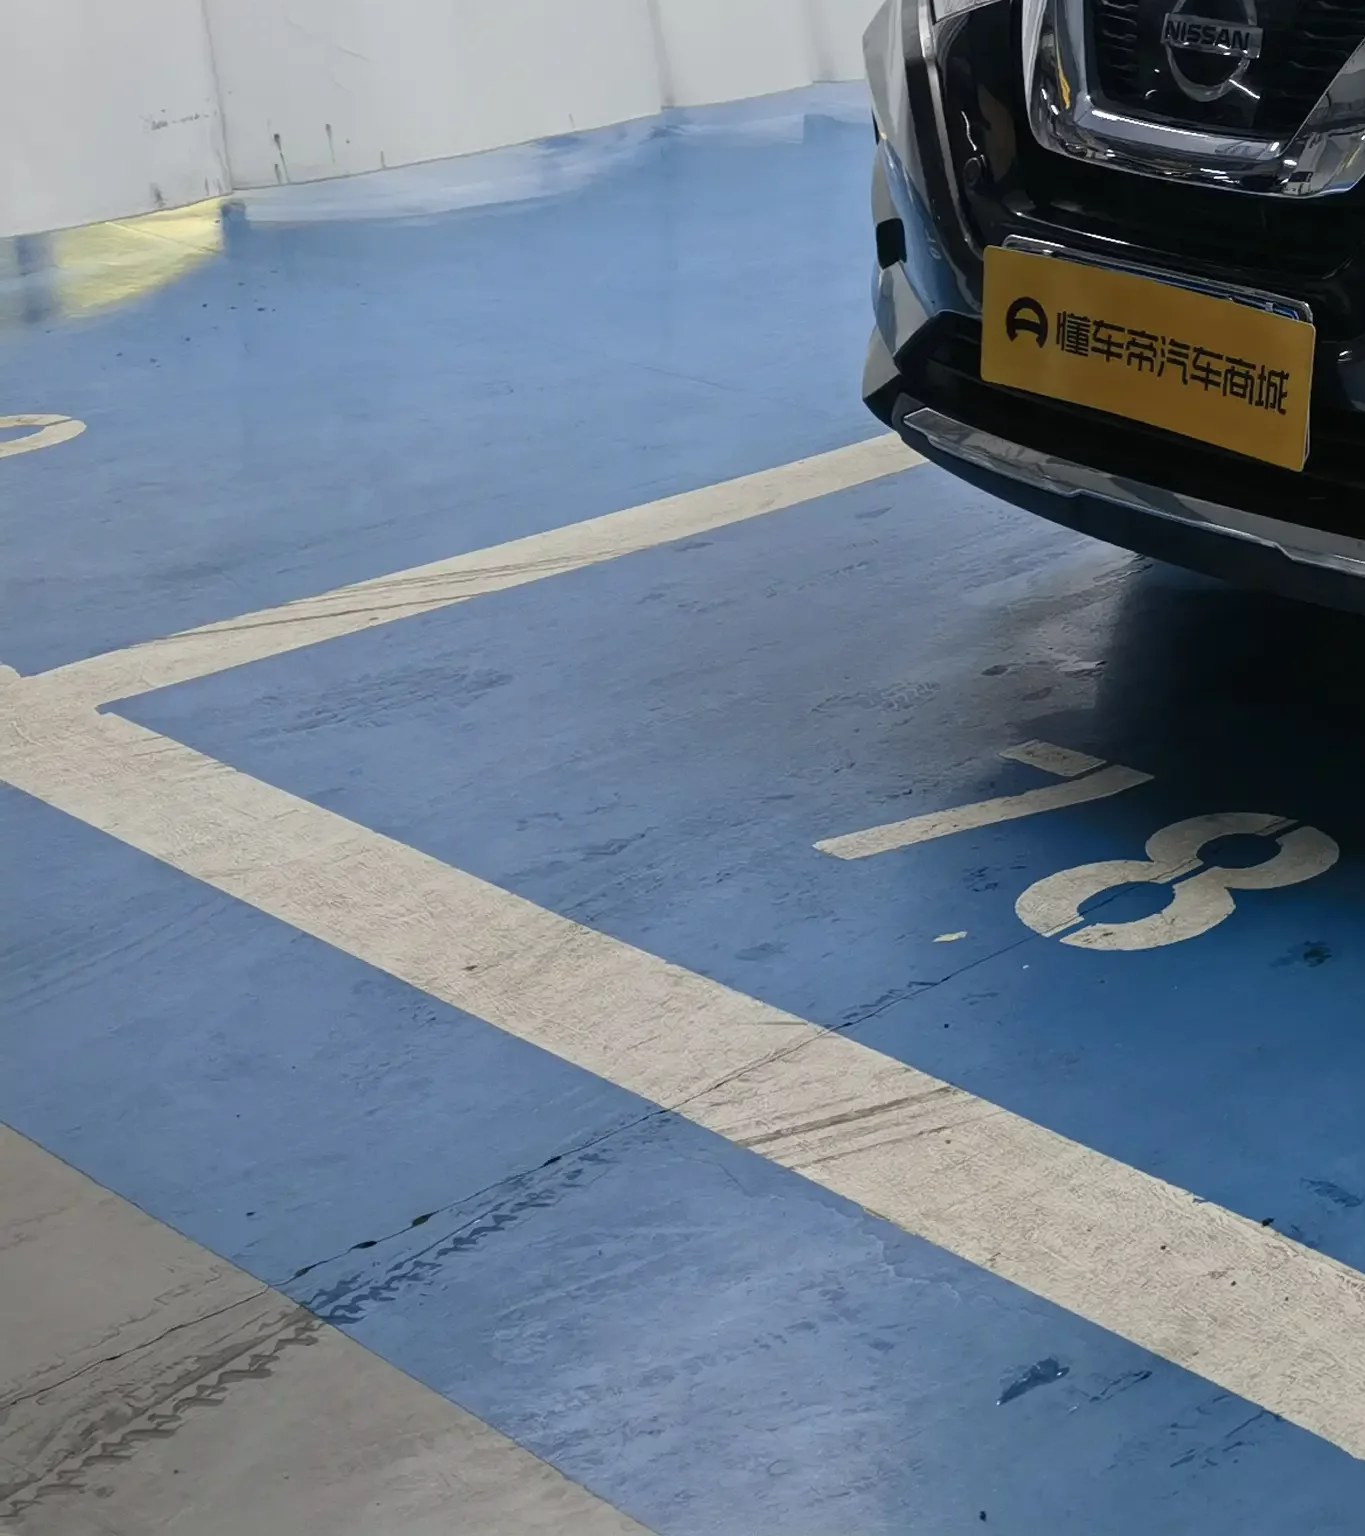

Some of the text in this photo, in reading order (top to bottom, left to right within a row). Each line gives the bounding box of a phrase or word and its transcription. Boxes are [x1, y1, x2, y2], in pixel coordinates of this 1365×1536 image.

[1164, 20, 1250, 51] NISSAN
[1056, 310, 1290, 415] 懂车帝汽车商城
